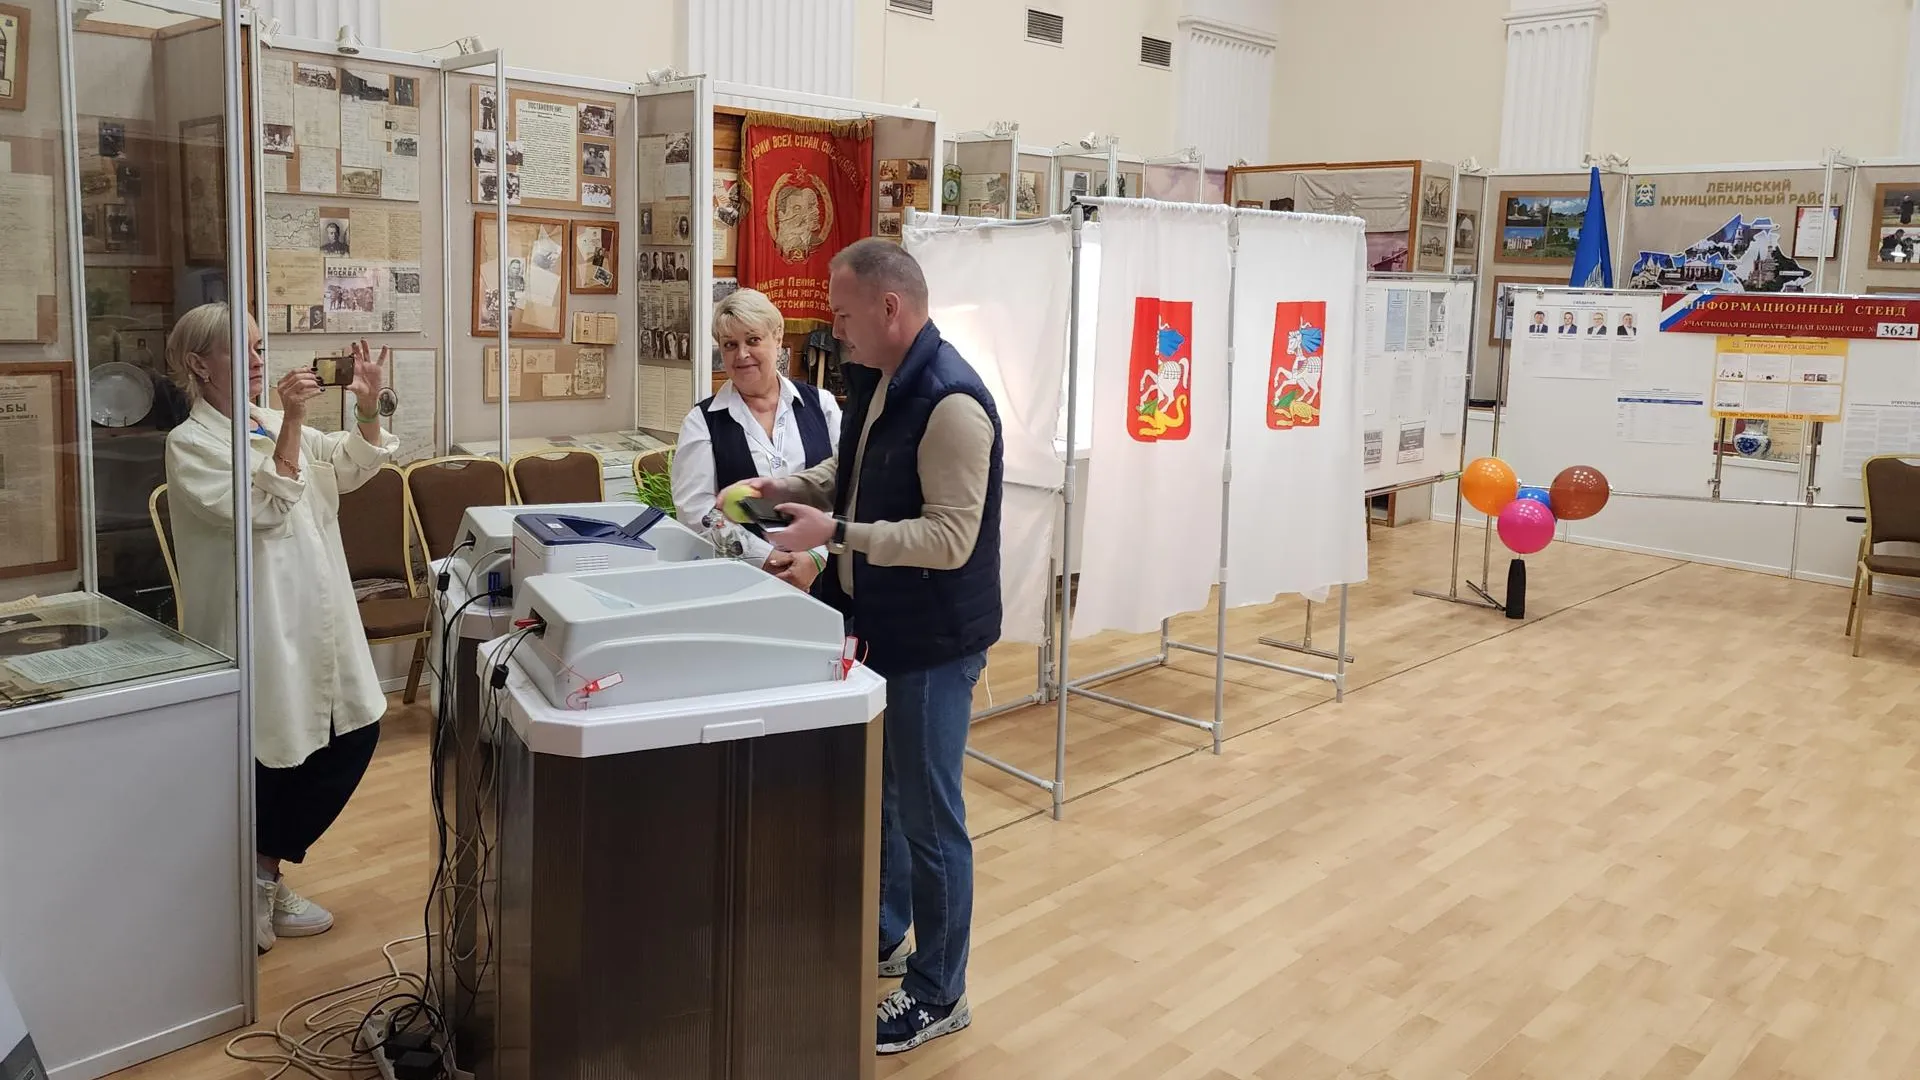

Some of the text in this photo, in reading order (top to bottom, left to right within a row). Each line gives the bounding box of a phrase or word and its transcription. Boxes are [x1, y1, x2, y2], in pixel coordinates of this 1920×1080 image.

[772, 134, 793, 149] ВСЕХ
[1706, 179, 1791, 193] ЛЕНИНСКИЙ
[1660, 193, 1785, 207] МУНИЦИПАЛЬНЫЙ
[1684, 301, 1906, 318] ИНФОРМАЦИОННЫЙ СТЕНД
[1682, 320, 1739, 328] УЧАСТКОВАЯ
[1741, 322, 1814, 331] ИЗБИРАТЕЛЬНАЯ
[1816, 325, 1864, 333] КОМИССИЯ
[1881, 325, 1914, 336] 3624
